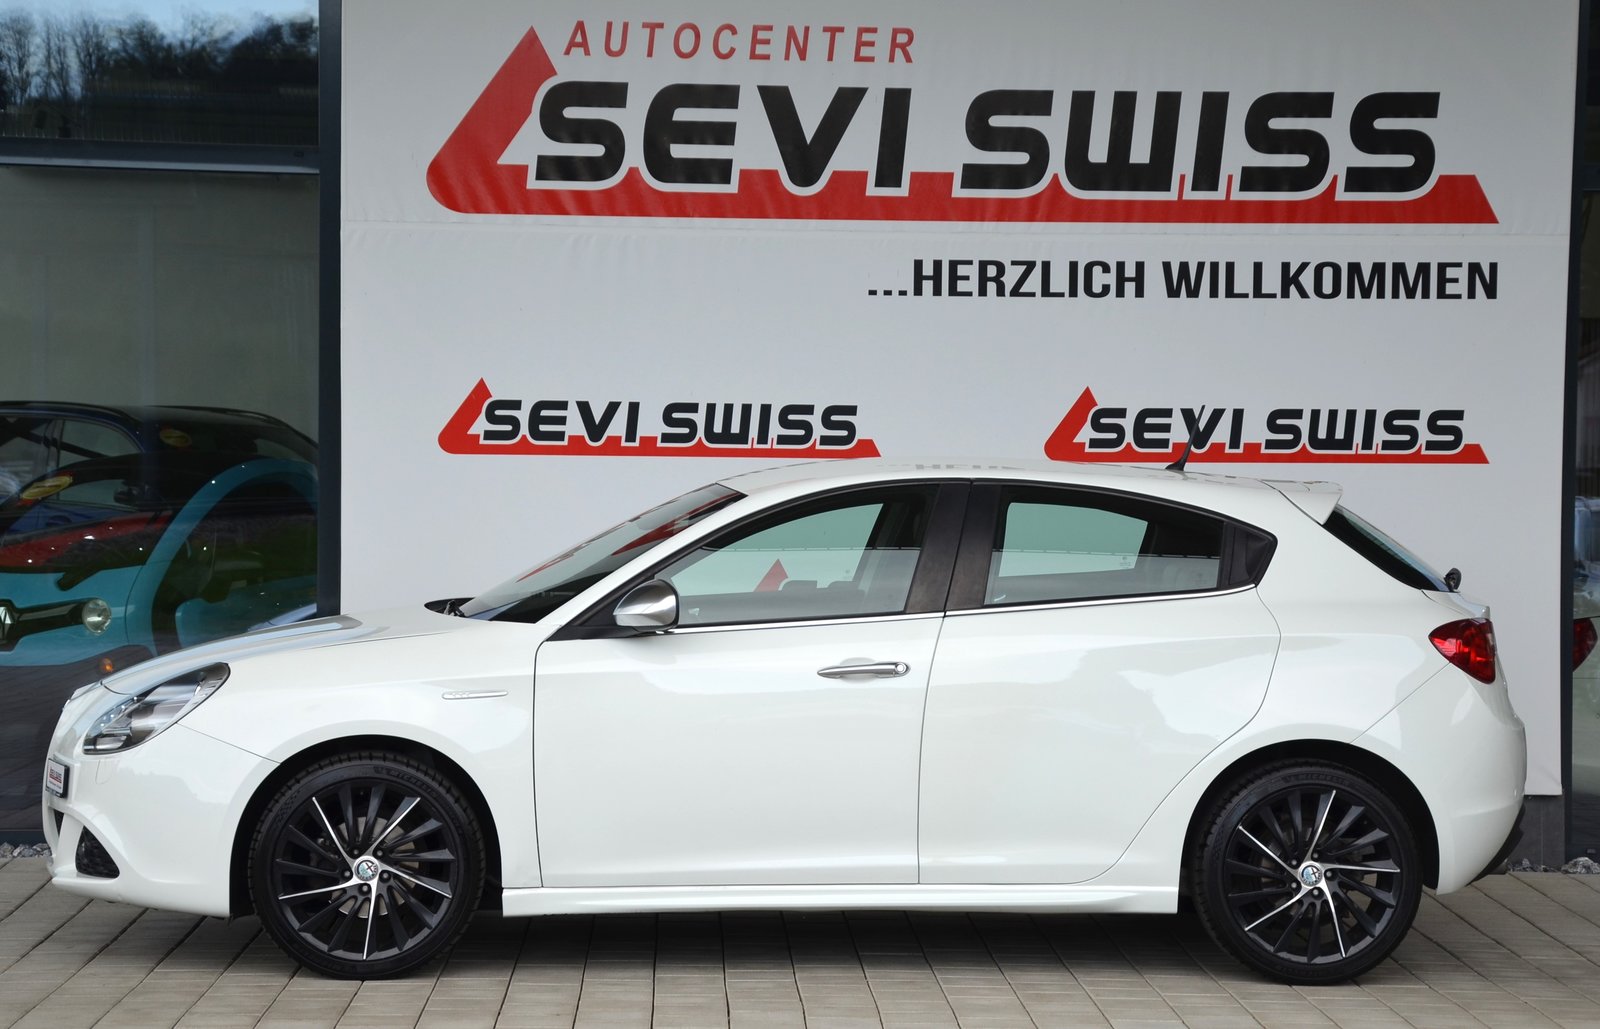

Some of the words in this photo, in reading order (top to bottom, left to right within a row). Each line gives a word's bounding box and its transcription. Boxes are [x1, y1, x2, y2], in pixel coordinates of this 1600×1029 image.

[563, 20, 915, 64] AUTOCENTER
[534, 80, 912, 189] SEVI
[960, 89, 1441, 193] SWISS
[1161, 261, 1499, 300] WILLKOMMEN
[482, 399, 640, 443] SEVI
[660, 402, 858, 446] SWISS
[1088, 407, 1245, 450] SEVI
[1264, 408, 1465, 452] SWISS
